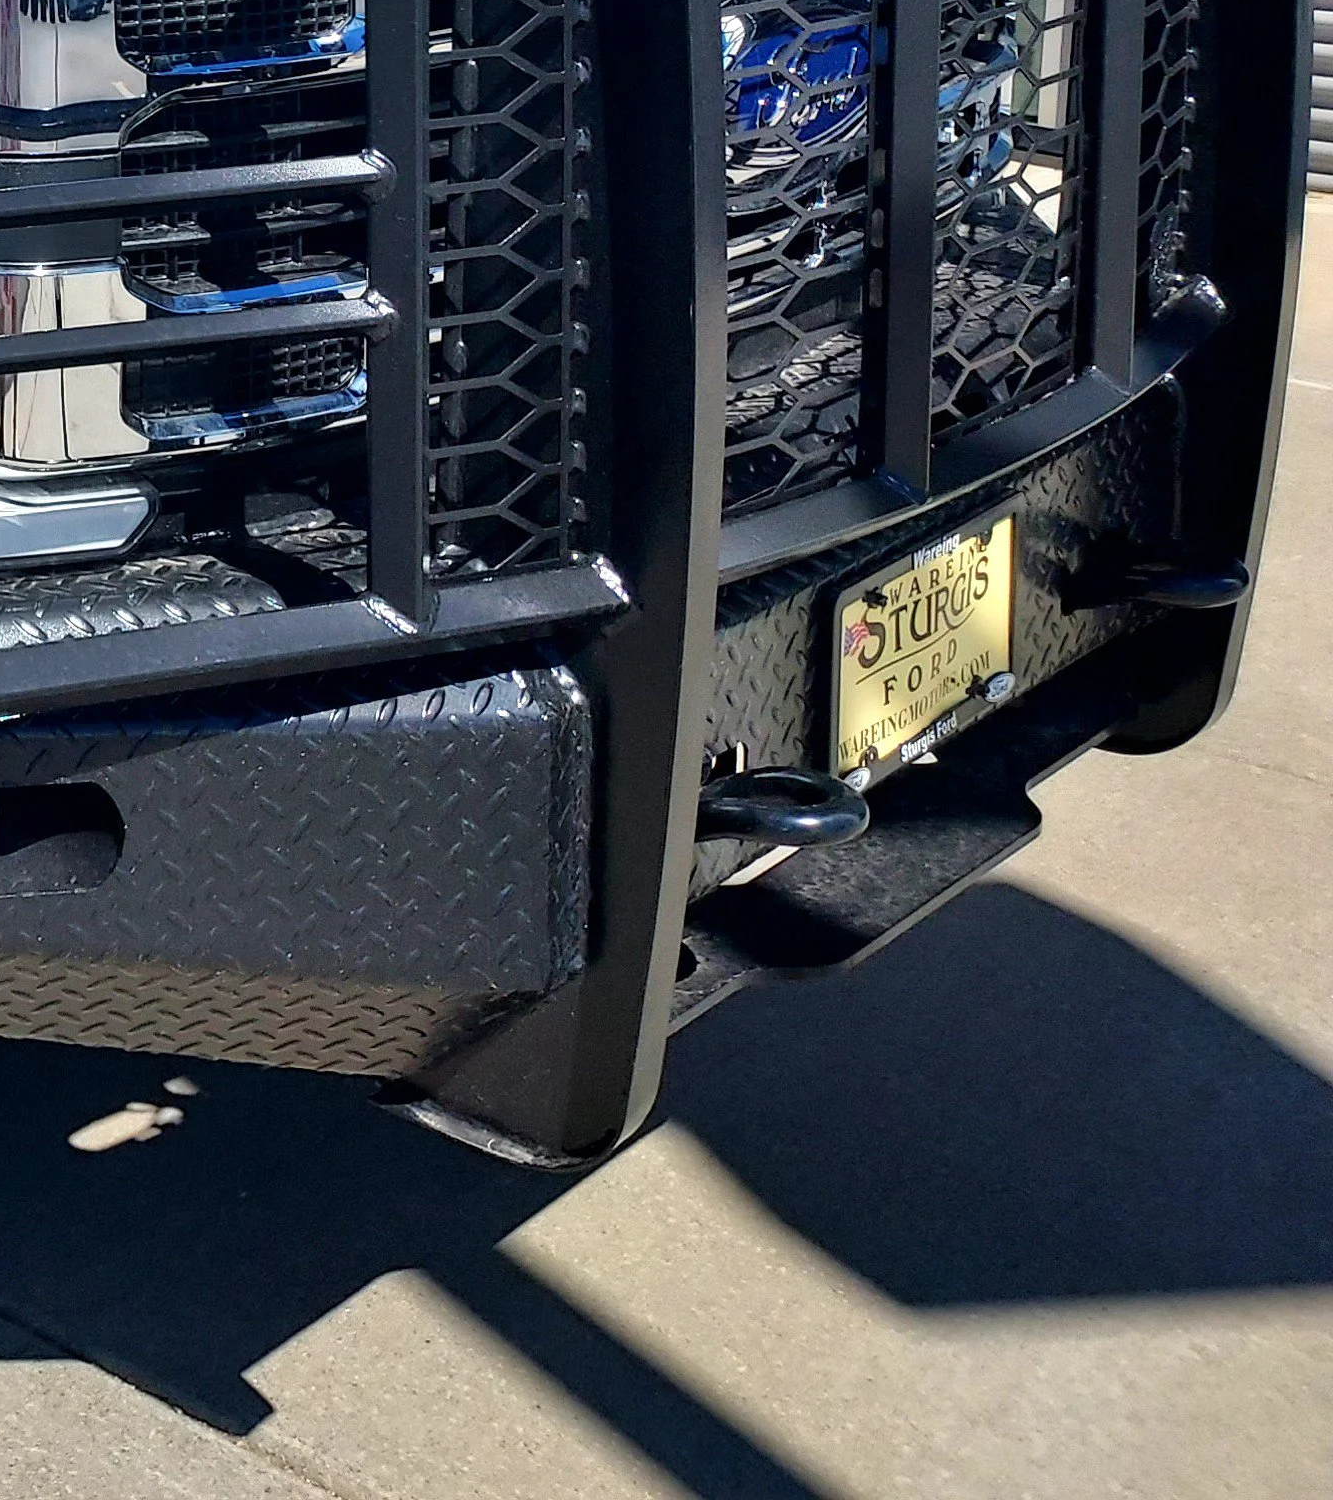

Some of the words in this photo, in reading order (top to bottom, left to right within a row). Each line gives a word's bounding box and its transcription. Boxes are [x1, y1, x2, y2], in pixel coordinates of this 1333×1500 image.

[913, 533, 961, 571] Wareing
[858, 555, 990, 669] STURGIS
[837, 650, 992, 762] WAREINGMOTORS.COM
[882, 637, 958, 706] FORD
[900, 728, 936, 764] Sturgis
[935, 710, 959, 739] Ford
